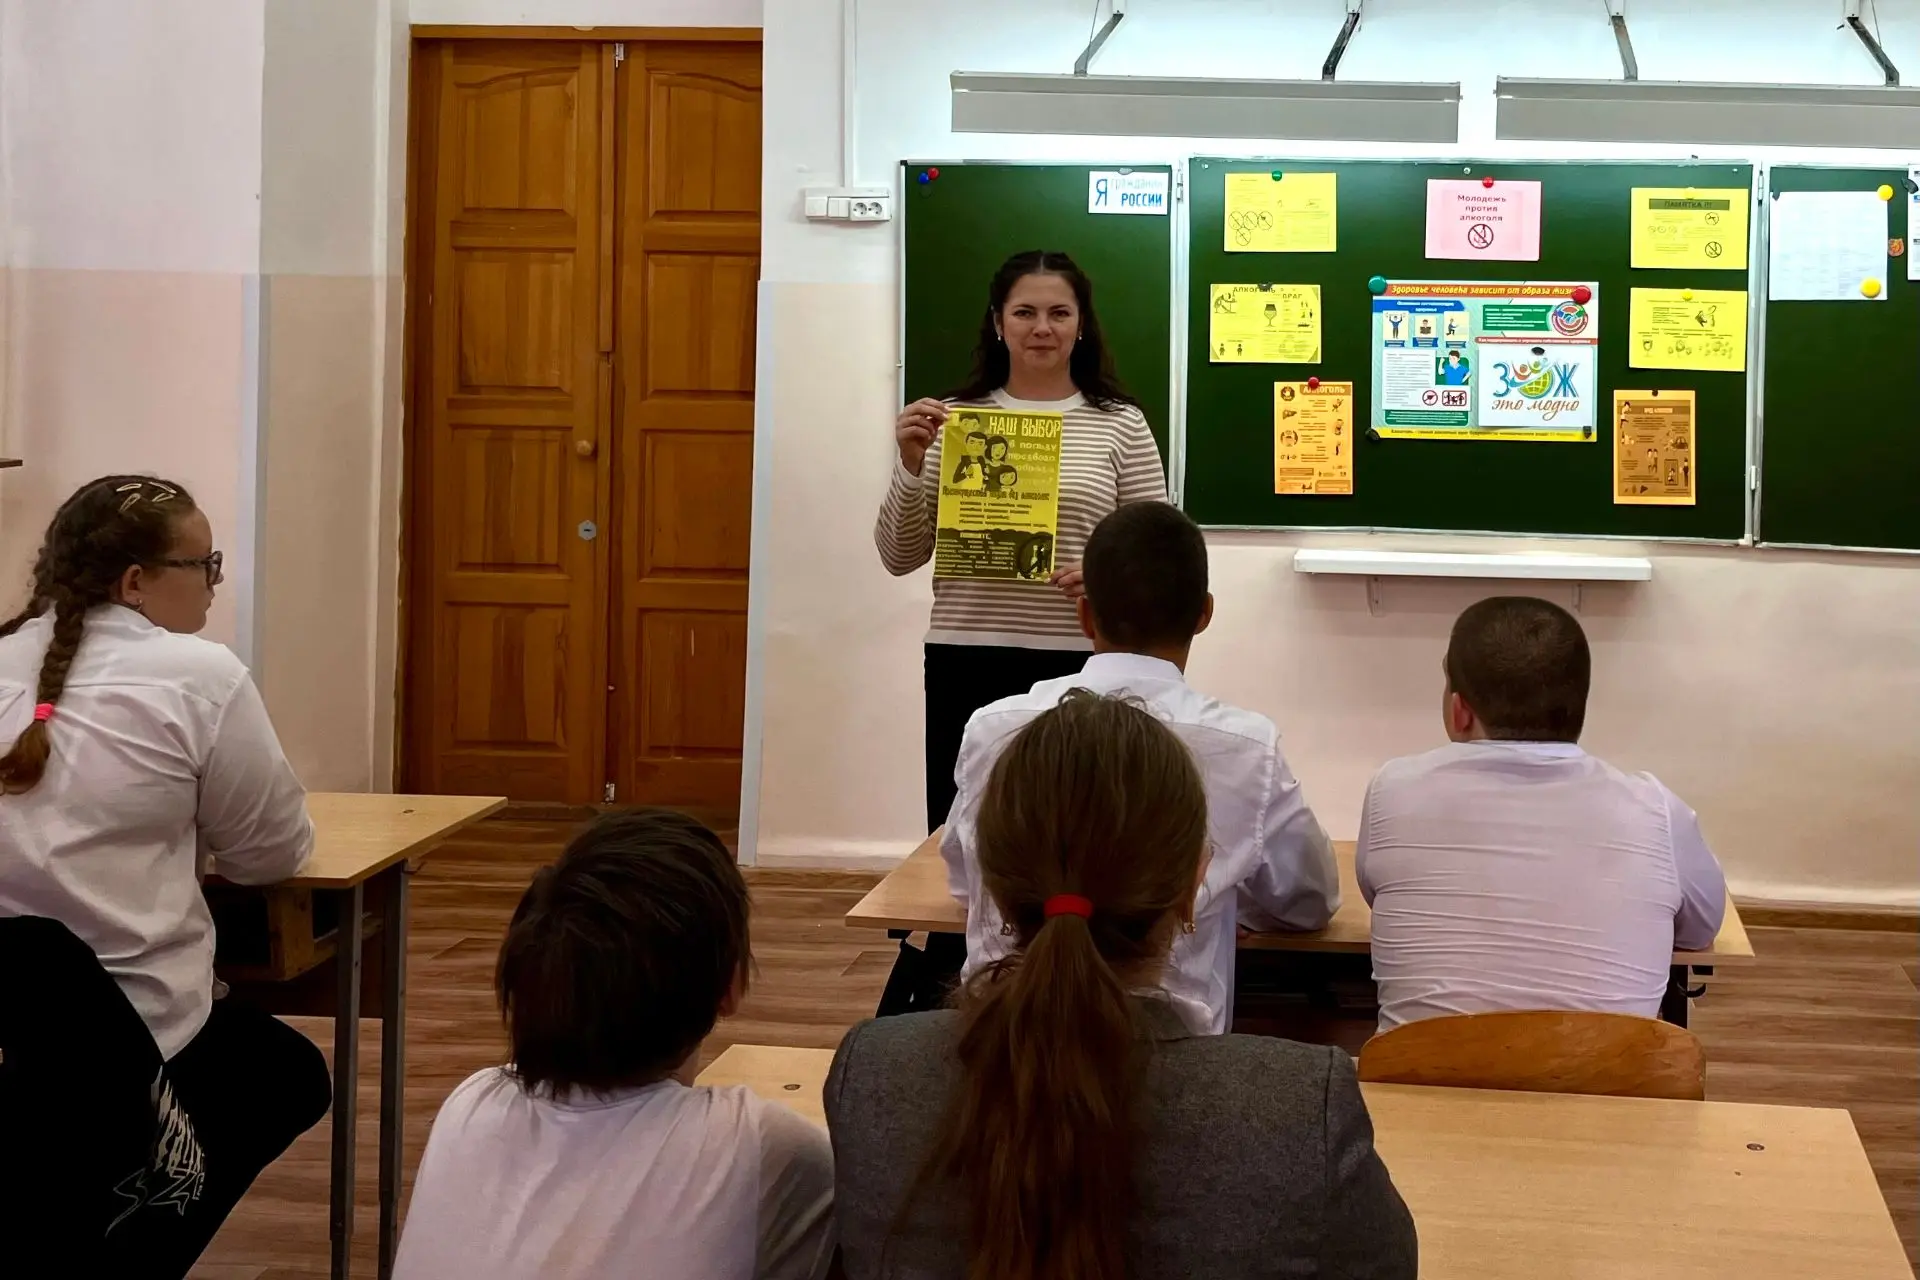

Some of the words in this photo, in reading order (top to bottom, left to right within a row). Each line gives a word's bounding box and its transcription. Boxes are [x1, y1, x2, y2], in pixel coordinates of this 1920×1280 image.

[1095, 178, 1108, 206] Я
[1121, 192, 1162, 207] РОССИИ
[1457, 194, 1507, 203] Молодежь
[1392, 285, 1429, 294] Здоровье
[1431, 286, 1468, 294] человека
[1470, 286, 1505, 294] зависит
[1522, 286, 1550, 295] образа
[1492, 399, 1524, 411] это
[1527, 399, 1580, 421] модно
[989, 415, 1018, 436] НАШ
[1021, 418, 1061, 438] ВЫБОР
